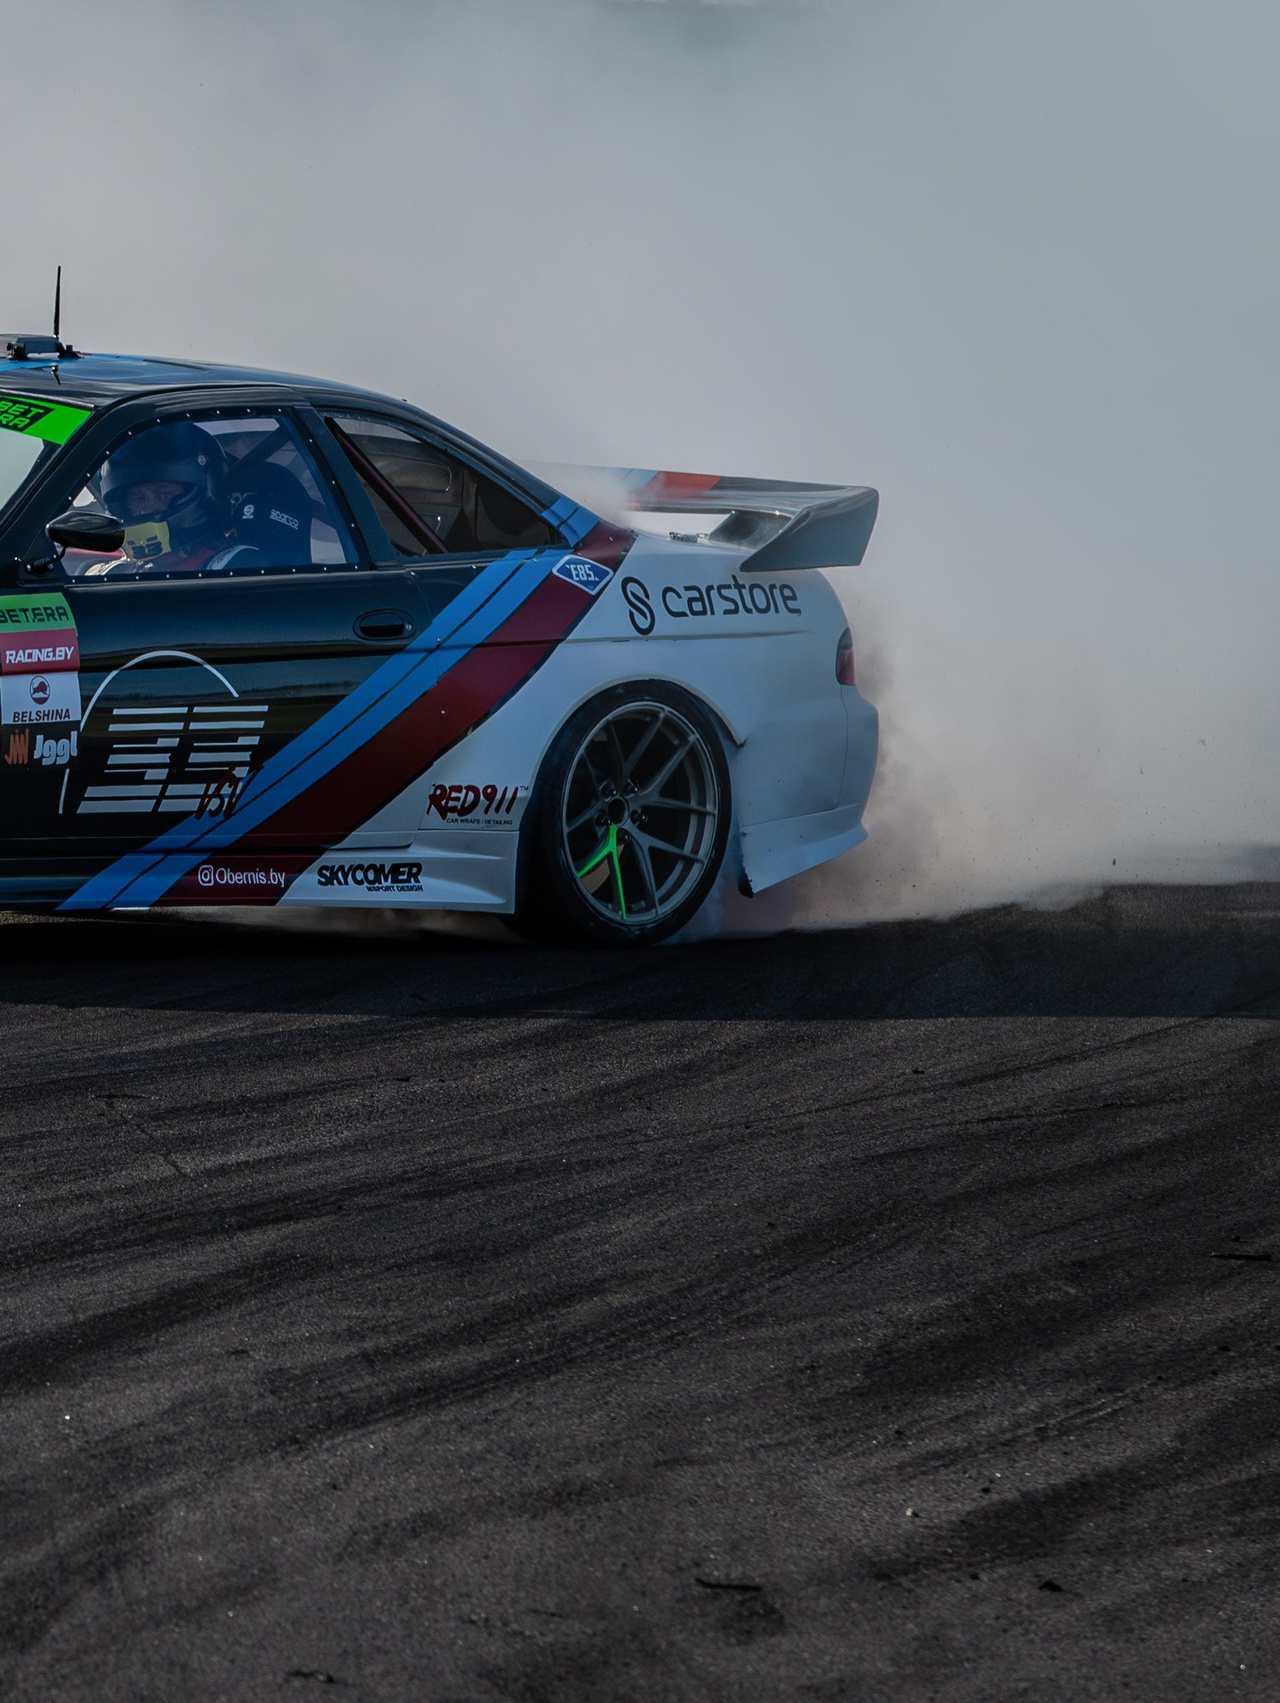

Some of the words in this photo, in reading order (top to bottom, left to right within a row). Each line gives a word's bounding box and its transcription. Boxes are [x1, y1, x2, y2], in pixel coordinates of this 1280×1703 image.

[661, 575, 802, 618] carstore
[5, 646, 75, 664] RACING.BY
[12, 708, 71, 723] BELSHINA
[215, 867, 286, 887] Obernis.by
[317, 862, 422, 886] SKYCOMER
[396, 884, 424, 893] DESIGN
